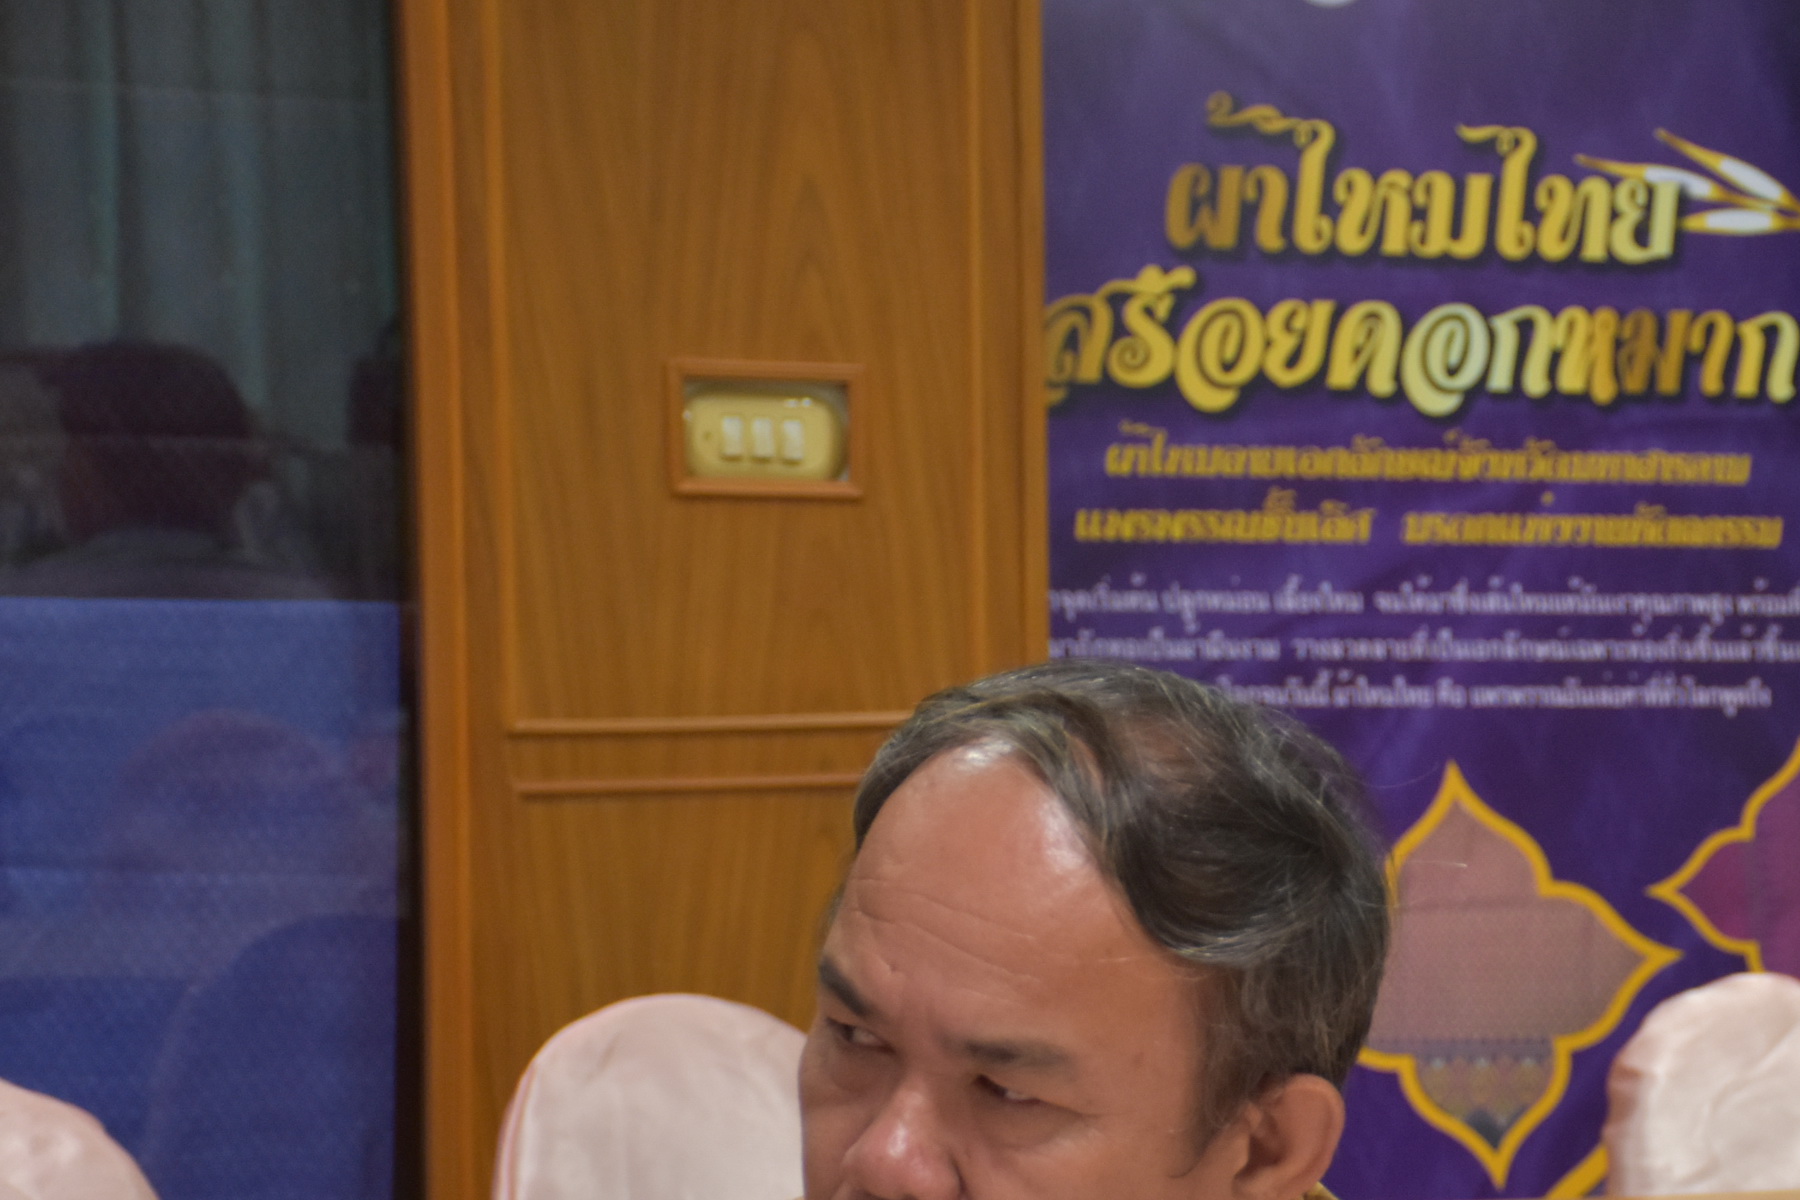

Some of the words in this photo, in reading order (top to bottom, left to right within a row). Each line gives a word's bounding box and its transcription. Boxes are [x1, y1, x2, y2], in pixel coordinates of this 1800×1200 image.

[1164, 90, 1682, 265] ผ้าไหมไทย
[1045, 264, 1800, 416] สร้อยดอกหมาก
